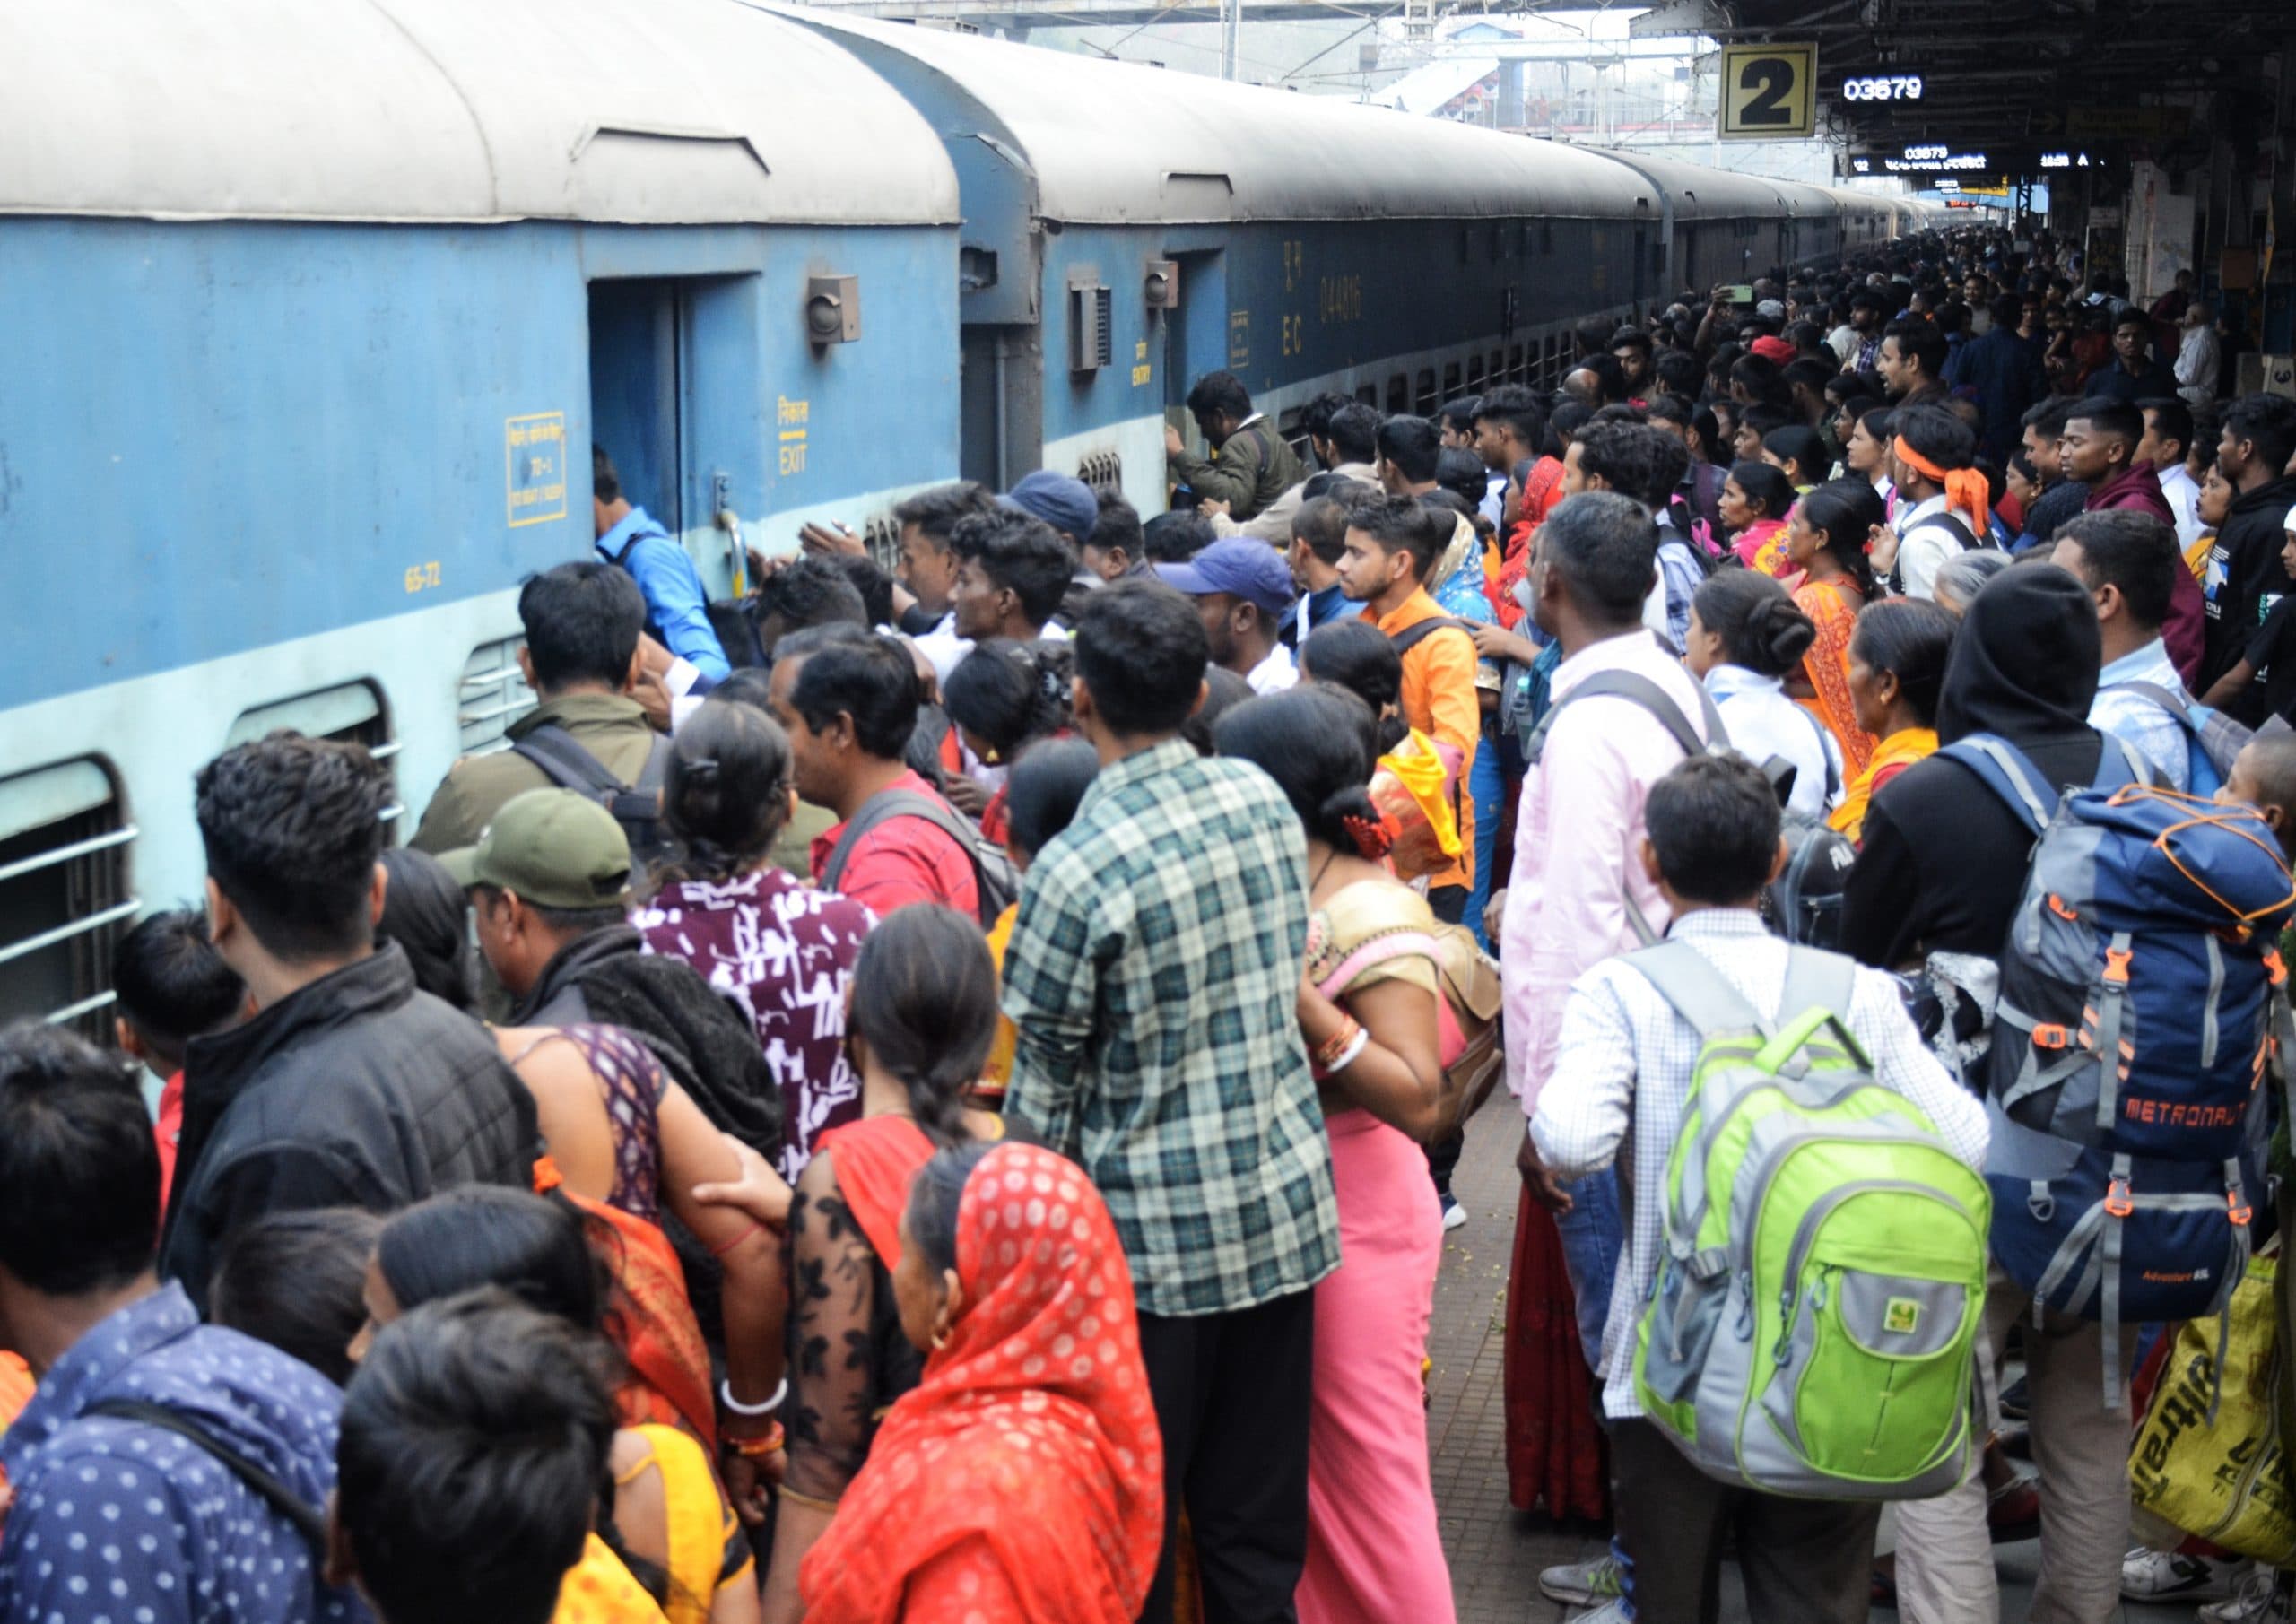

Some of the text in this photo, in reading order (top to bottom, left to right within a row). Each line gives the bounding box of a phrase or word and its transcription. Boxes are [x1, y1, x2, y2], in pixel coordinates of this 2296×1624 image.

[1740, 58, 1794, 125] 2
[1844, 76, 1922, 101] 03679
[780, 444, 807, 475] EXIT
[404, 560, 441, 594] 65-72
